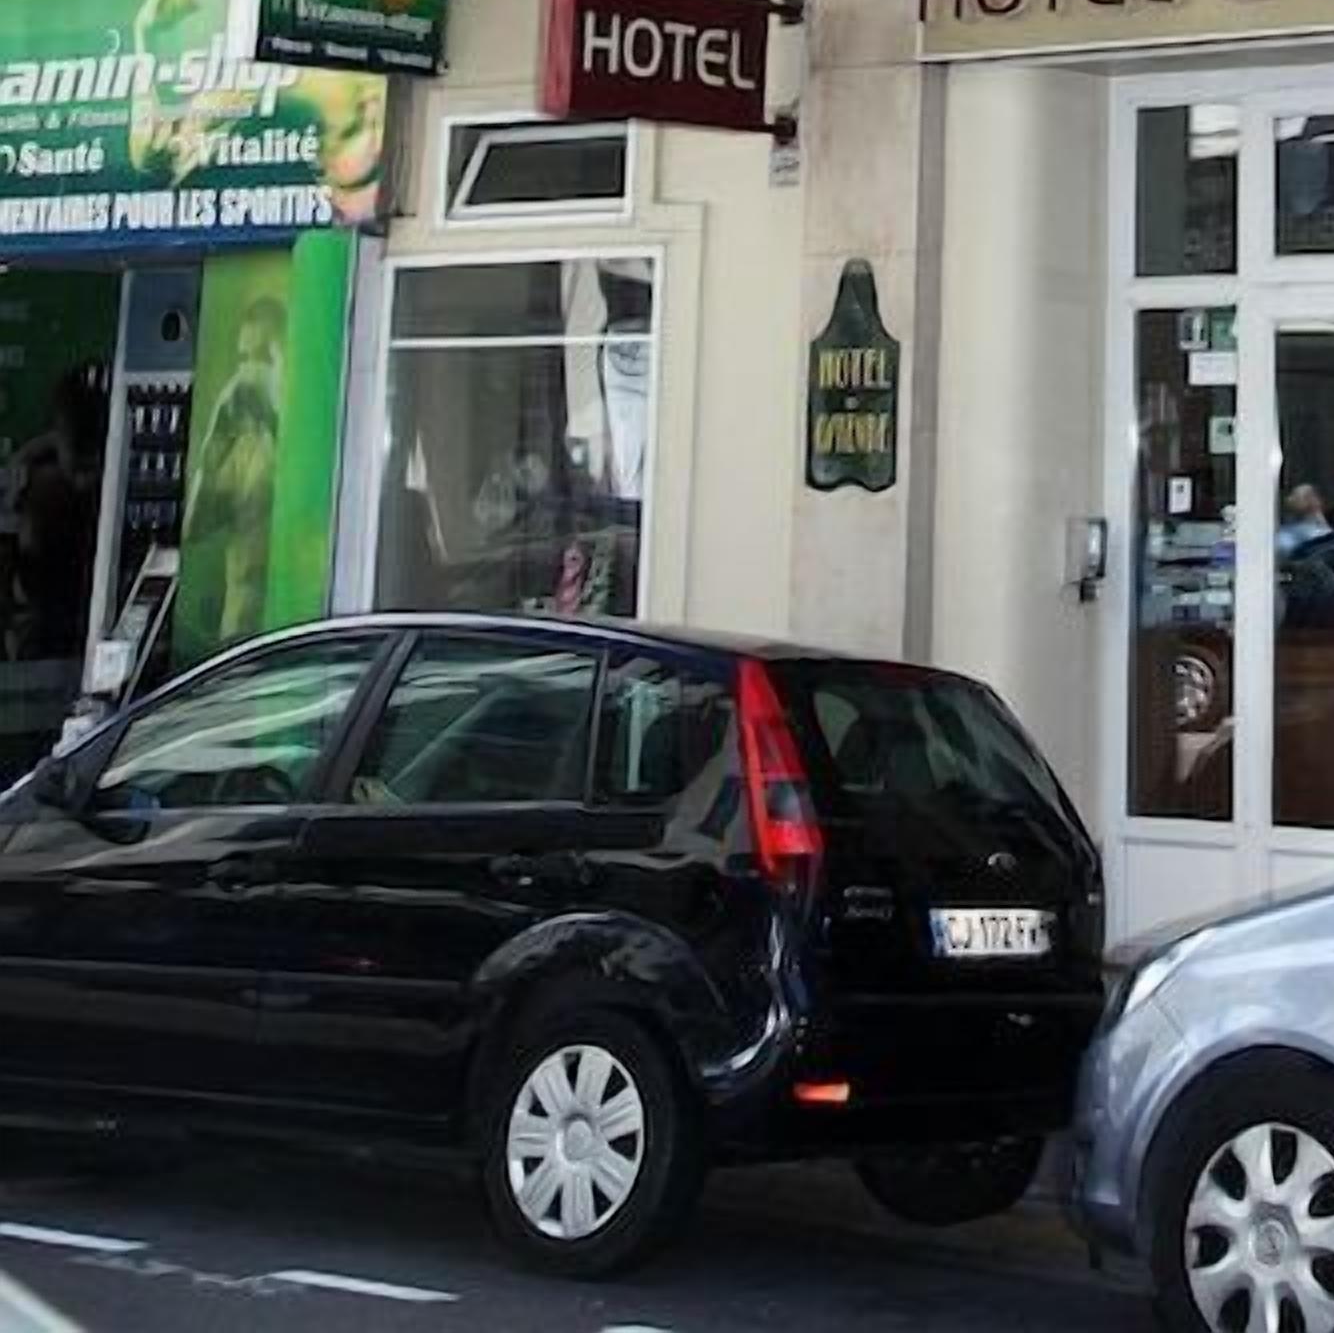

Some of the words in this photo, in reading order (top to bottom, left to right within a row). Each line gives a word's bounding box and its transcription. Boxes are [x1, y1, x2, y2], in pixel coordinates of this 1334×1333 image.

[582, 10, 756, 89] HOTEL
[17, 137, 105, 176] Santé
[112, 191, 174, 230] POUR
[179, 188, 217, 226] LES
